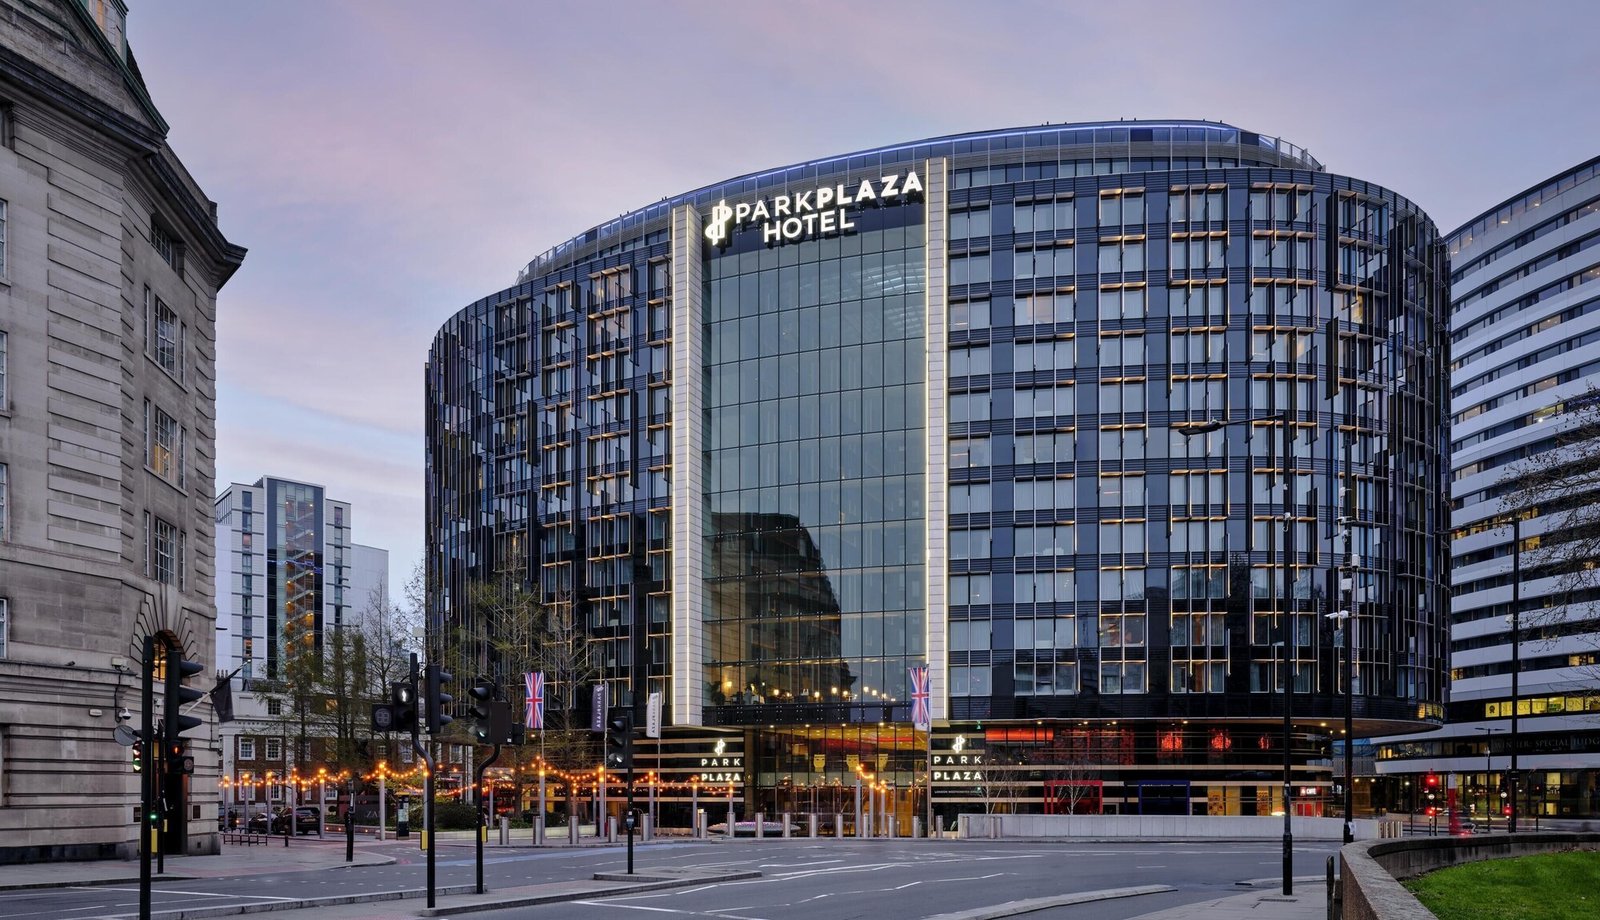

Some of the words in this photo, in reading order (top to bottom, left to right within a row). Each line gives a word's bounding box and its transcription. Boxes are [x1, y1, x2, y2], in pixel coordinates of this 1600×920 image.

[763, 208, 855, 243] HOTEL
[1535, 738, 1569, 748] SPECIAL
[701, 758, 741, 766] PARK
[934, 756, 982, 764] PARK
[701, 773, 741, 781] PLAZA
[934, 772, 982, 780] PLAZA
